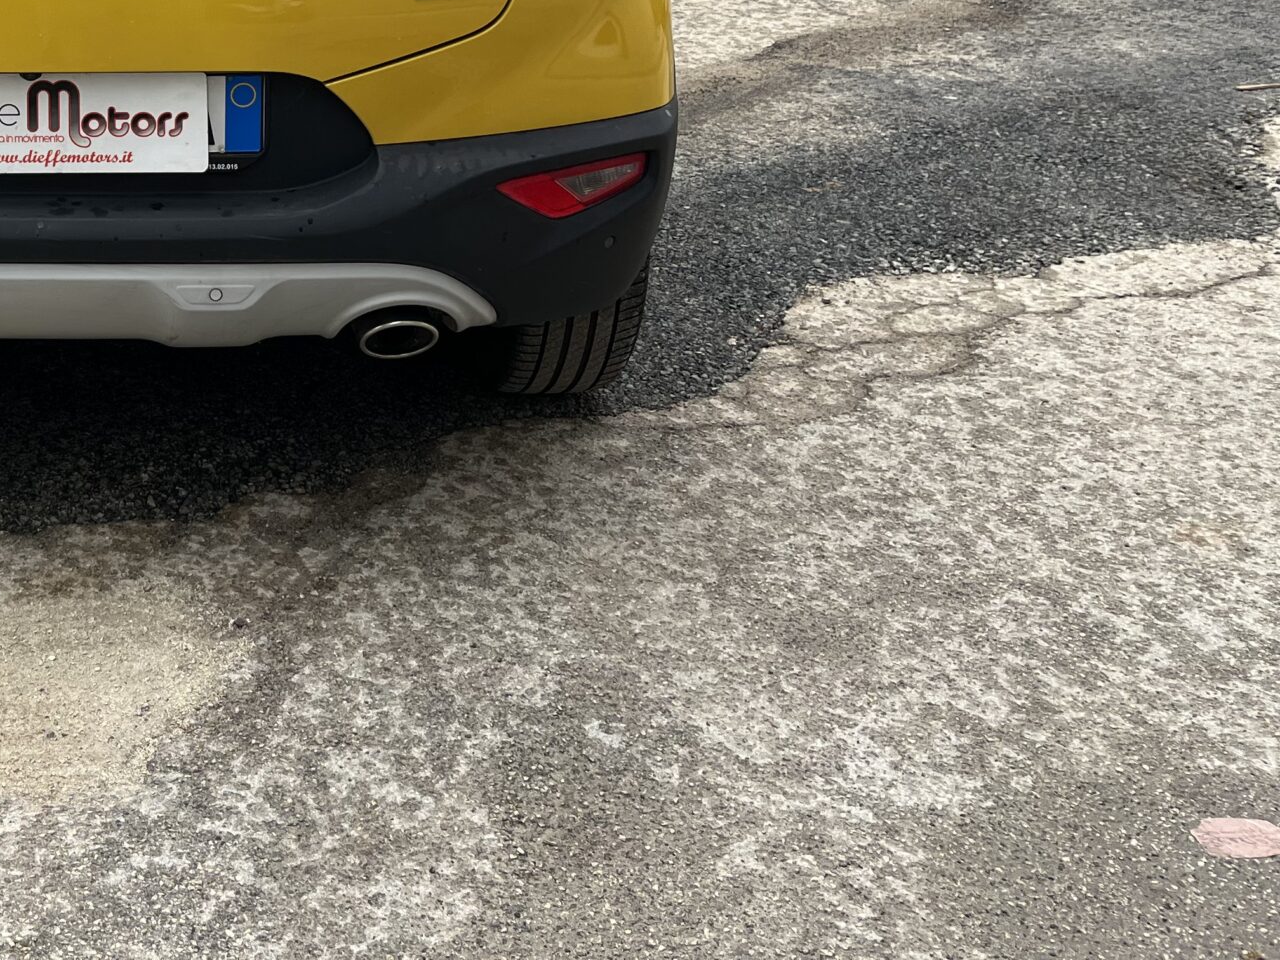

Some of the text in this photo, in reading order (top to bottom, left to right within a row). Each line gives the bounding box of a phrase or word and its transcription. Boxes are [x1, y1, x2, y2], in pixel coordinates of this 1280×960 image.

[26, 79, 190, 148] Motors
[6, 134, 14, 144] in
[14, 133, 65, 143] movimento
